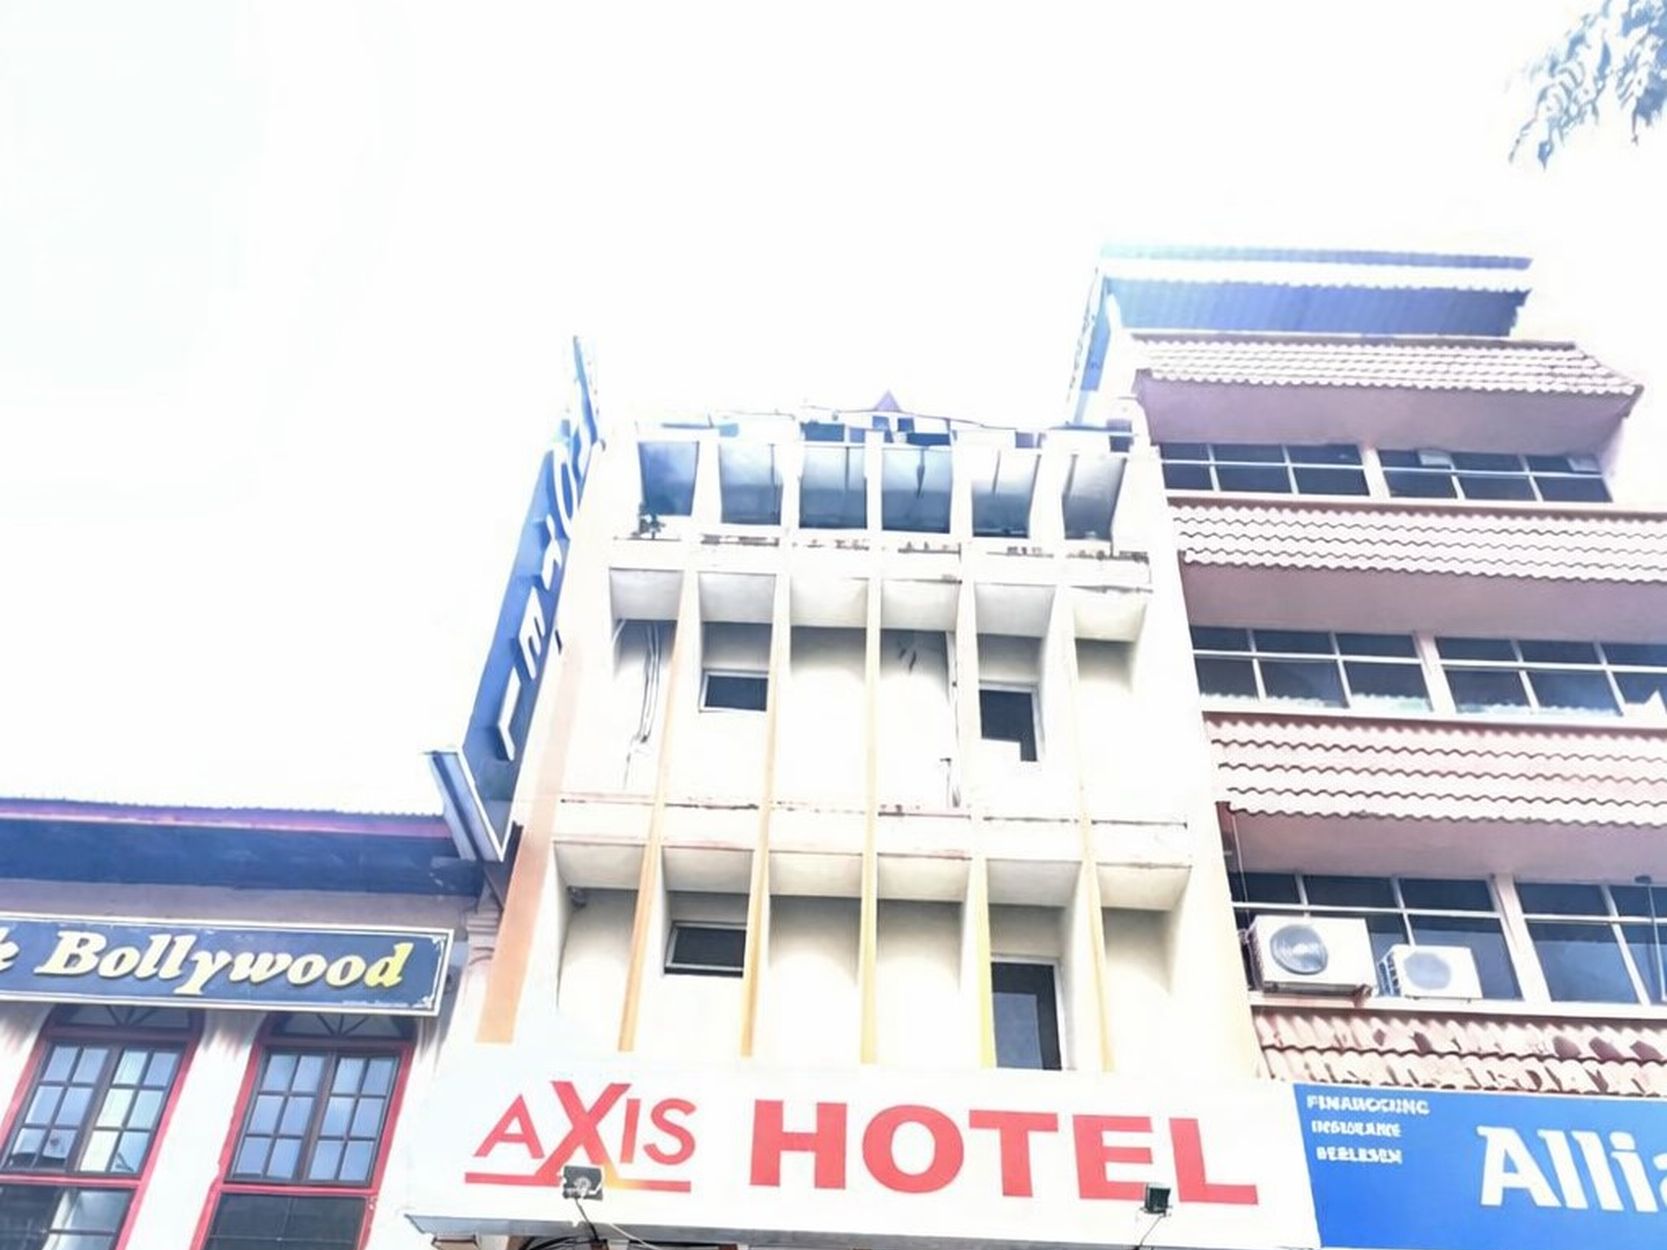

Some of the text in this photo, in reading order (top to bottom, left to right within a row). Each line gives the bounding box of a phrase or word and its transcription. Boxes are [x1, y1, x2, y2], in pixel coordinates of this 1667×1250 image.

[34, 930, 413, 995] Bollywood
[470, 1080, 1260, 1205] AXIS HOTEL
[1476, 1125, 1667, 1213] Alli
